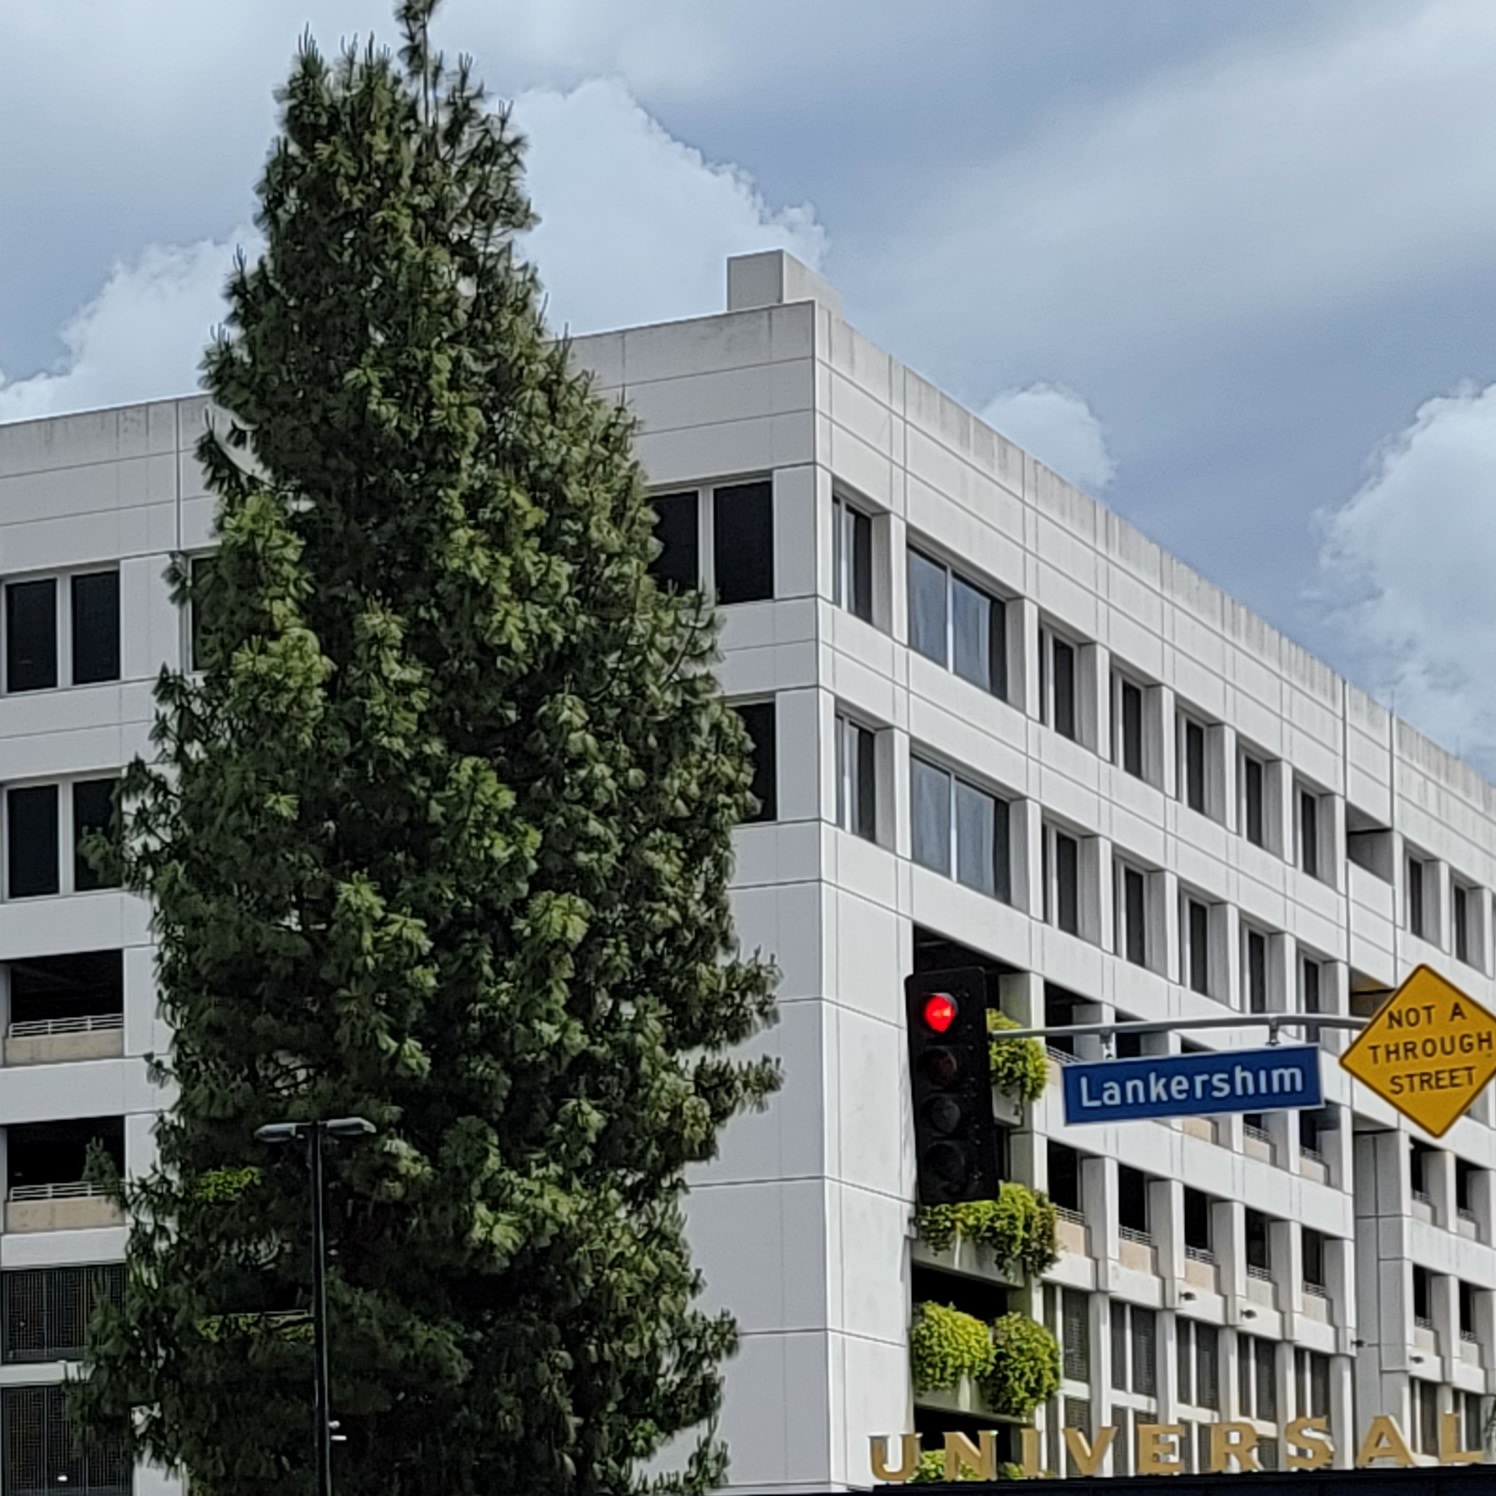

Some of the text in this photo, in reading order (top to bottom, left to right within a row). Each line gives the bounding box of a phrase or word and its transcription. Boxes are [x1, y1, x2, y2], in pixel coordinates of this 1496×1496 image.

[1386, 1002, 1468, 1029] NOT A
[1367, 1030, 1493, 1065] THROUGH
[1080, 1064, 1303, 1108] Lankershim
[1389, 1066, 1477, 1095] STREET
[868, 1412, 1484, 1482] UNIVERSAL
